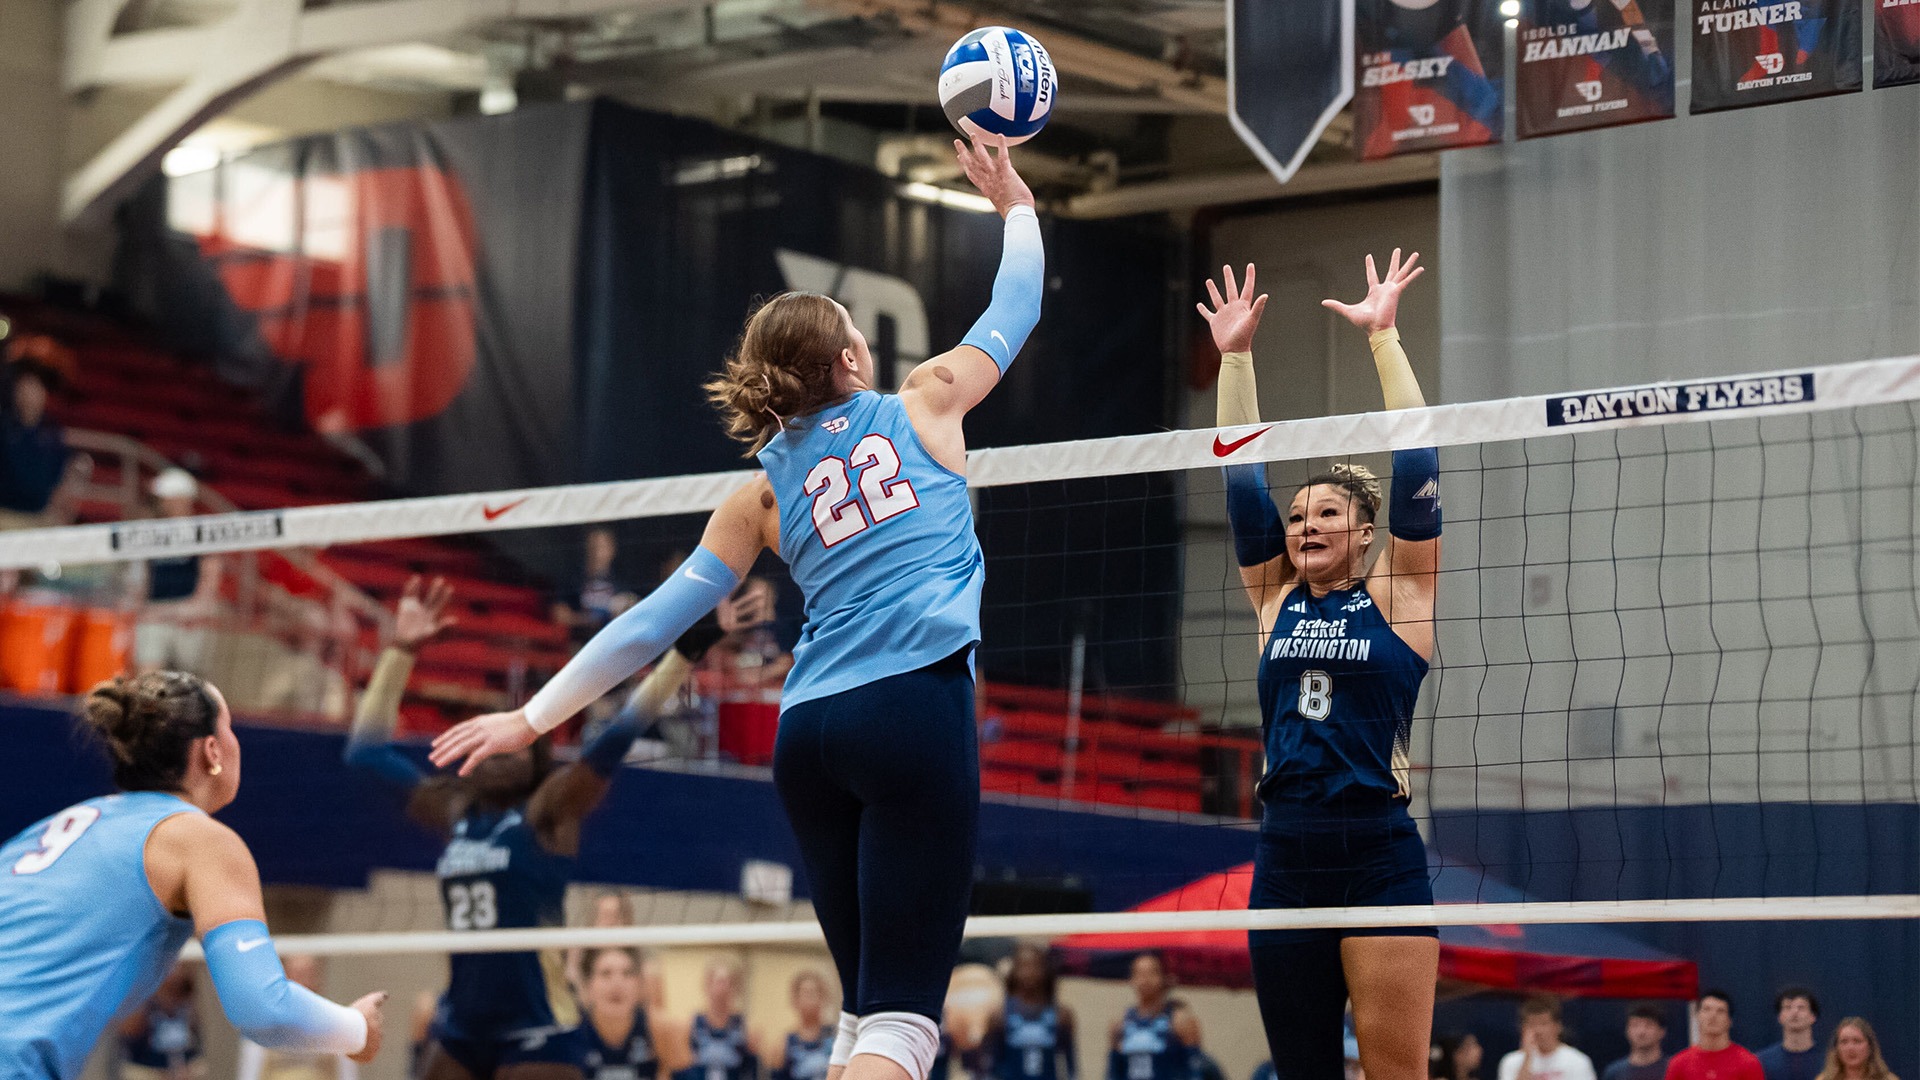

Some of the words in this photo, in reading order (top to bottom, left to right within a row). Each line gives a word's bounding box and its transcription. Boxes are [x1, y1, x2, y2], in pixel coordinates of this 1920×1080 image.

[1523, 23, 1577, 41] ISOLDE
[1698, 1, 1802, 35] TURNER
[1524, 27, 1631, 62] HANNAN
[997, 68, 1010, 100] Touch
[1012, 41, 1035, 94] NCAA
[1031, 40, 1051, 103] molten
[1362, 56, 1454, 88] SELSKY
[1736, 78, 1774, 91] DAYTON
[1776, 72, 1812, 86] FLYERS
[1561, 386, 1679, 424] DAYTON
[1684, 375, 1805, 411] FLYERS
[803, 432, 921, 549] 22
[1292, 618, 1348, 639] GEORGE
[1269, 637, 1371, 662] WASHINGTON
[1298, 669, 1333, 722] 8
[12, 804, 102, 875] 9
[449, 880, 498, 930] 23
